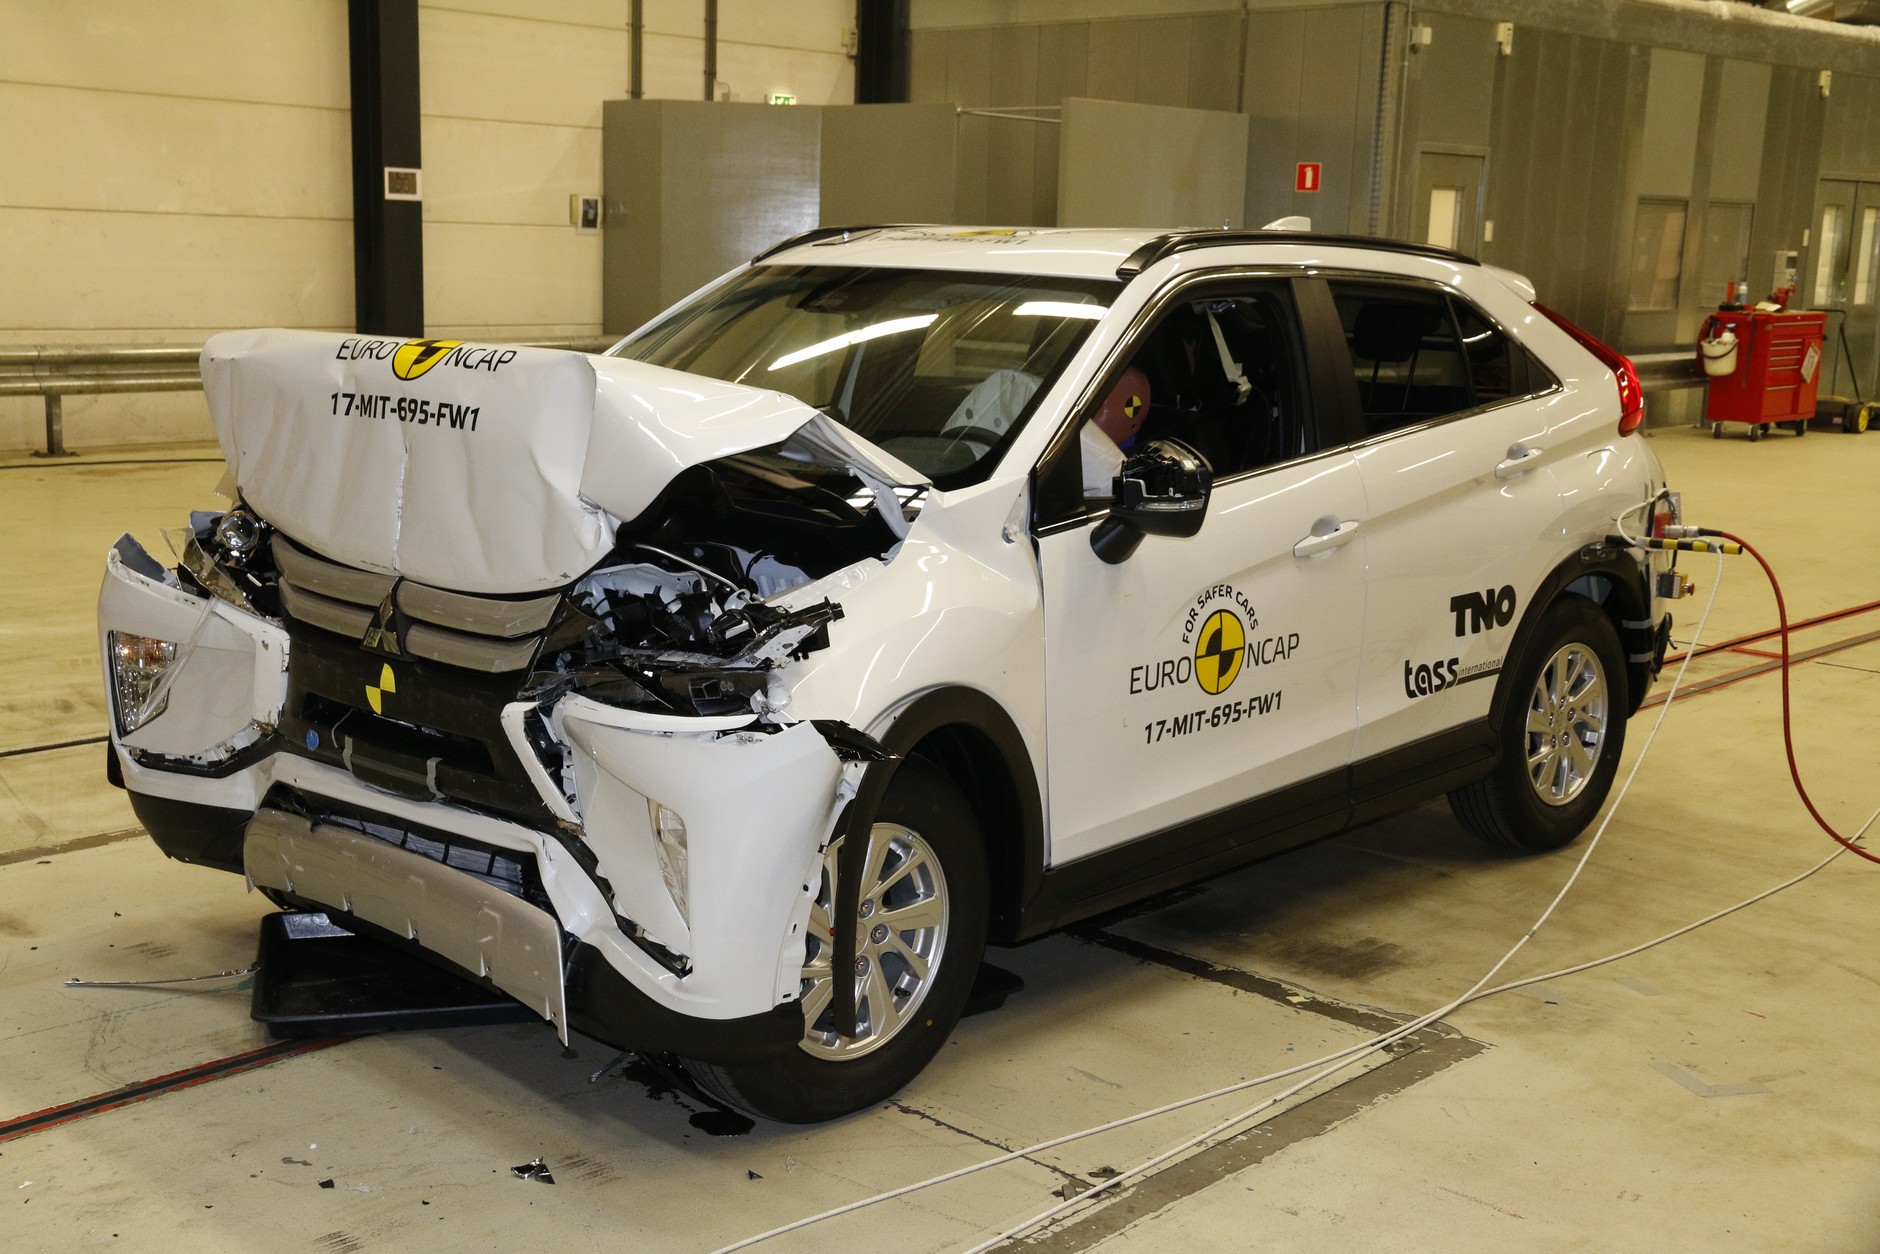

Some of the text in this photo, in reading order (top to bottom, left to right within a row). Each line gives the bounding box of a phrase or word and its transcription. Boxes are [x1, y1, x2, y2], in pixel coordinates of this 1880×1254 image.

[336, 338, 517, 372] EURO NCAP
[331, 391, 480, 432] 17-MIT-695-FW1
[1182, 584, 1259, 644] FOR SAFER CARS
[1450, 584, 1516, 637] TNO
[1129, 633, 1300, 695] EURO NCAP
[1458, 656, 1503, 676] international
[1144, 690, 1282, 744] 17-MIT-695-FW1
